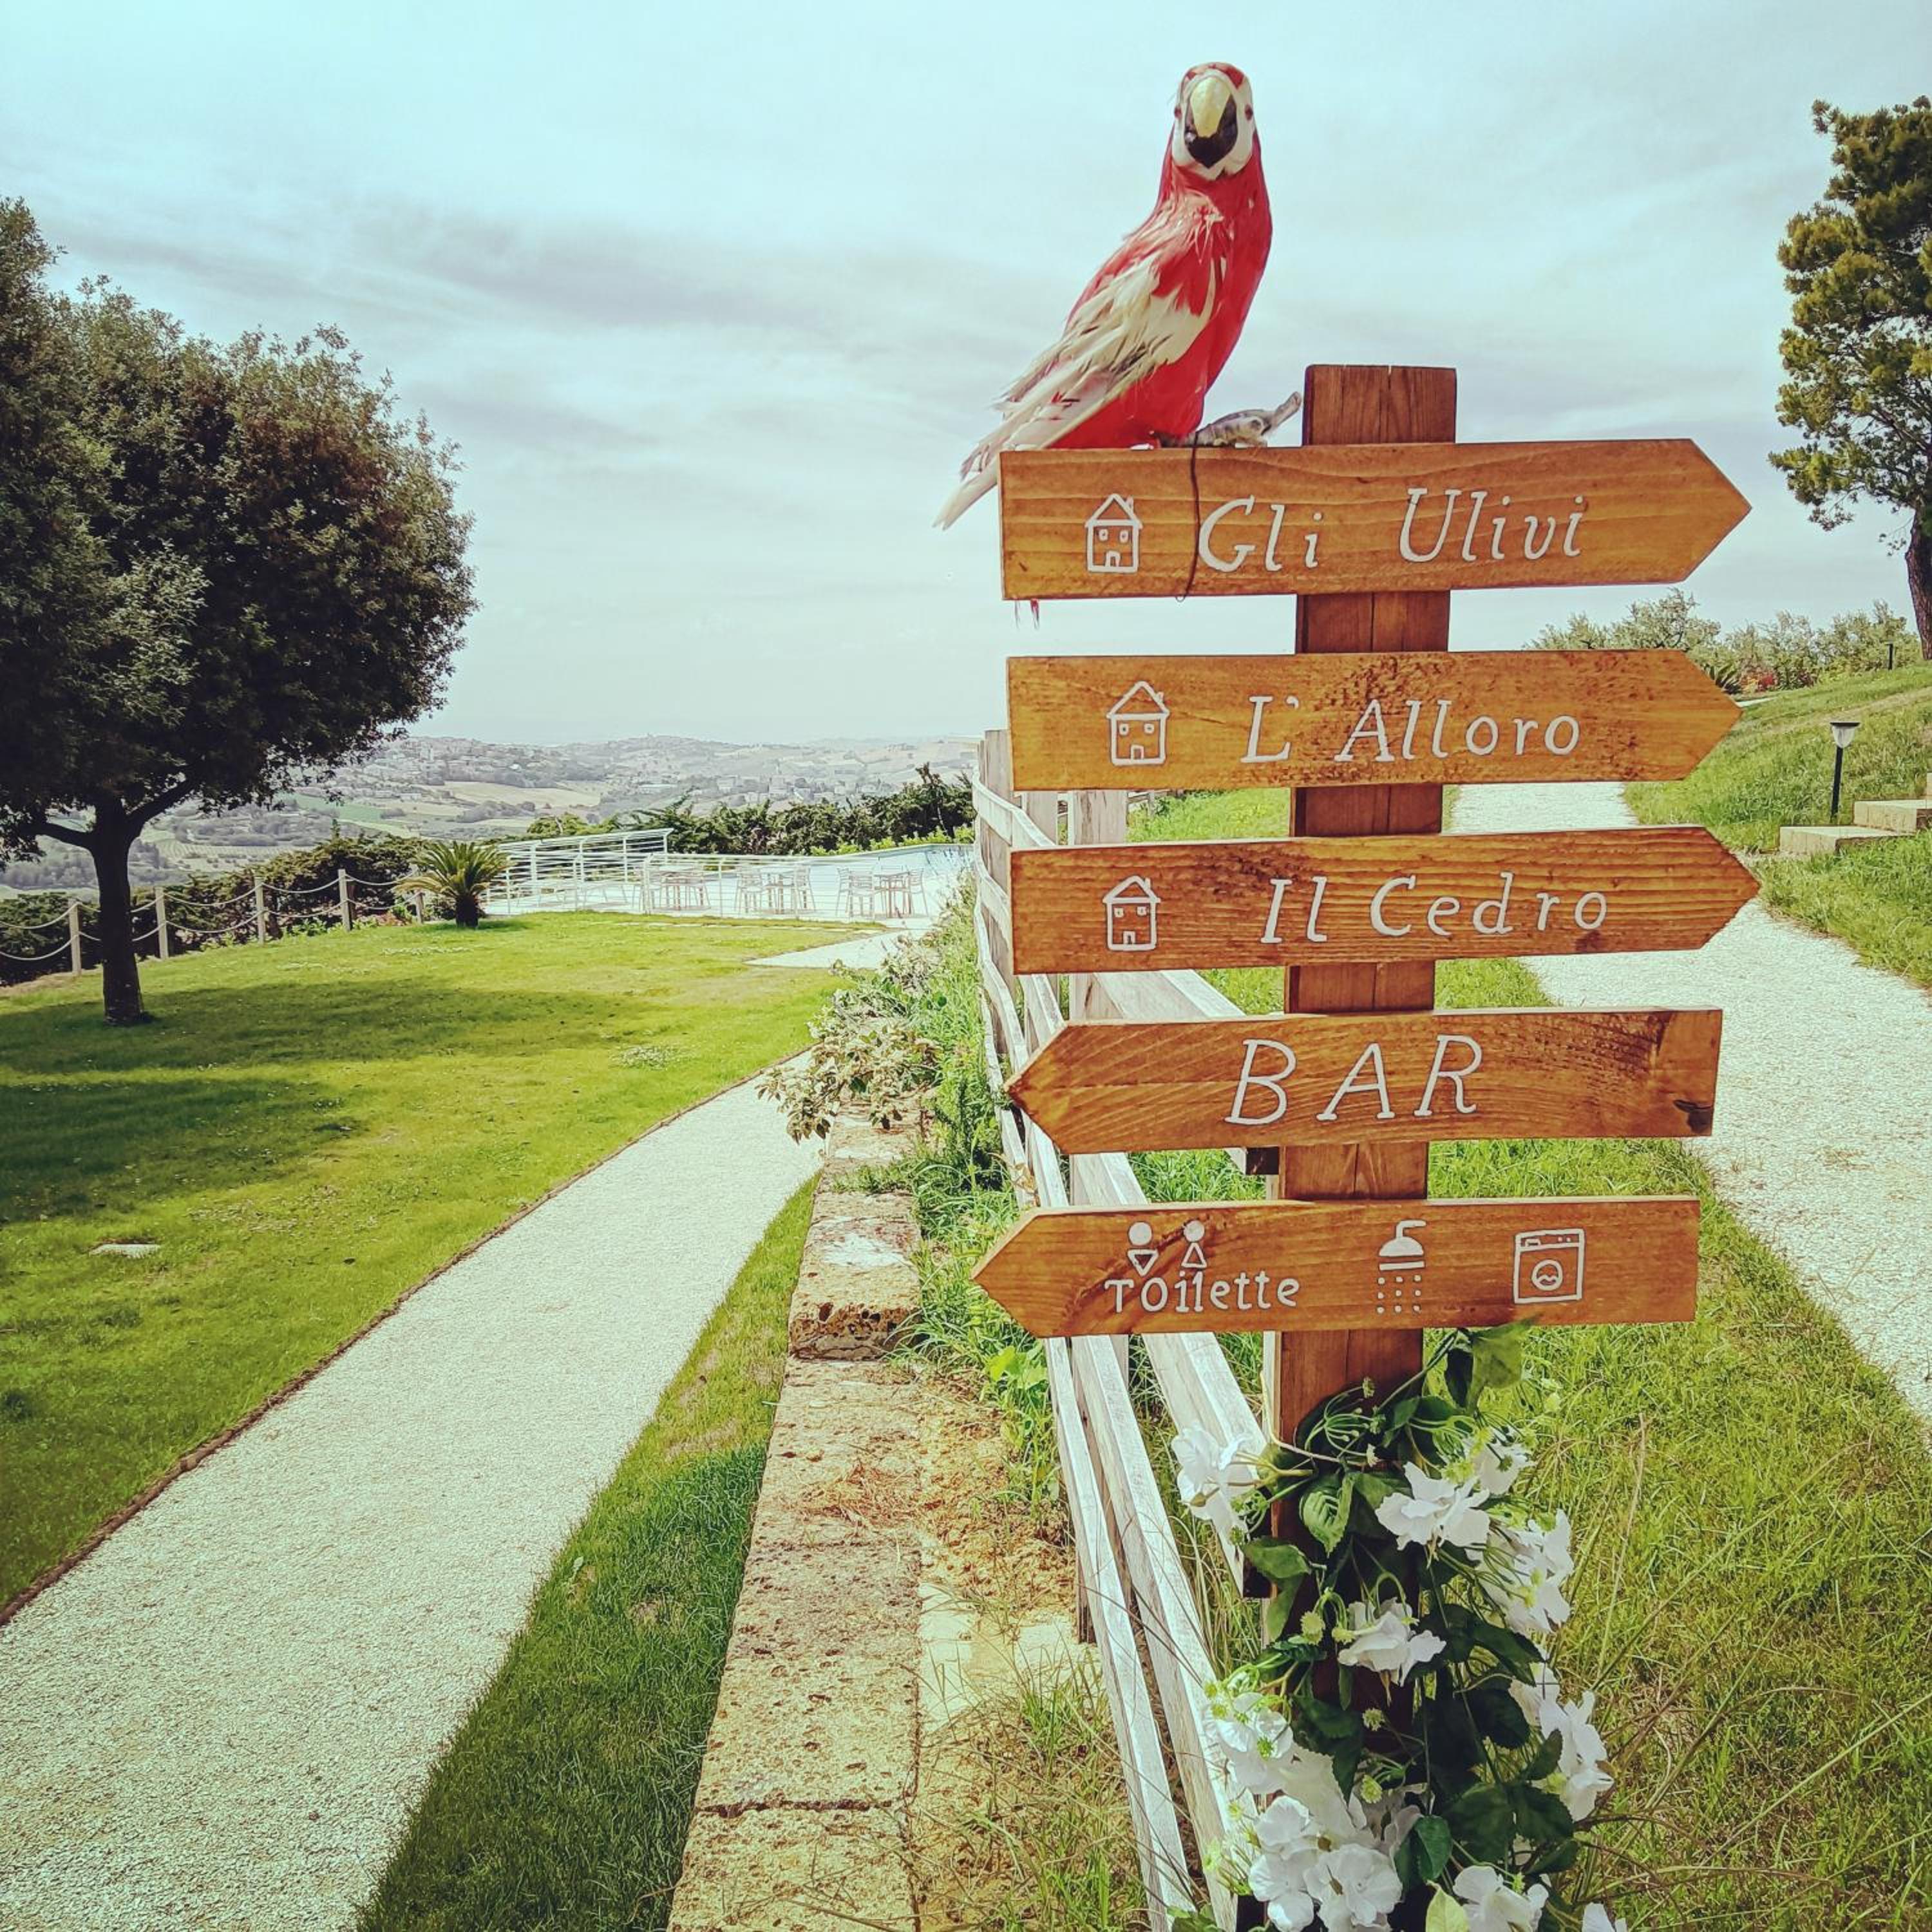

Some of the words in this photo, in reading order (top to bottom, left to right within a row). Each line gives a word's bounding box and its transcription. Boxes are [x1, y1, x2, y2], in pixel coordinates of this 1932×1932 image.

[1197, 495, 1325, 572] Gli
[1399, 488, 1586, 564] Ulivi
[1262, 875, 1328, 943] Il
[1370, 871, 1607, 938] Cedro
[1225, 1034, 1484, 1126] BAR
